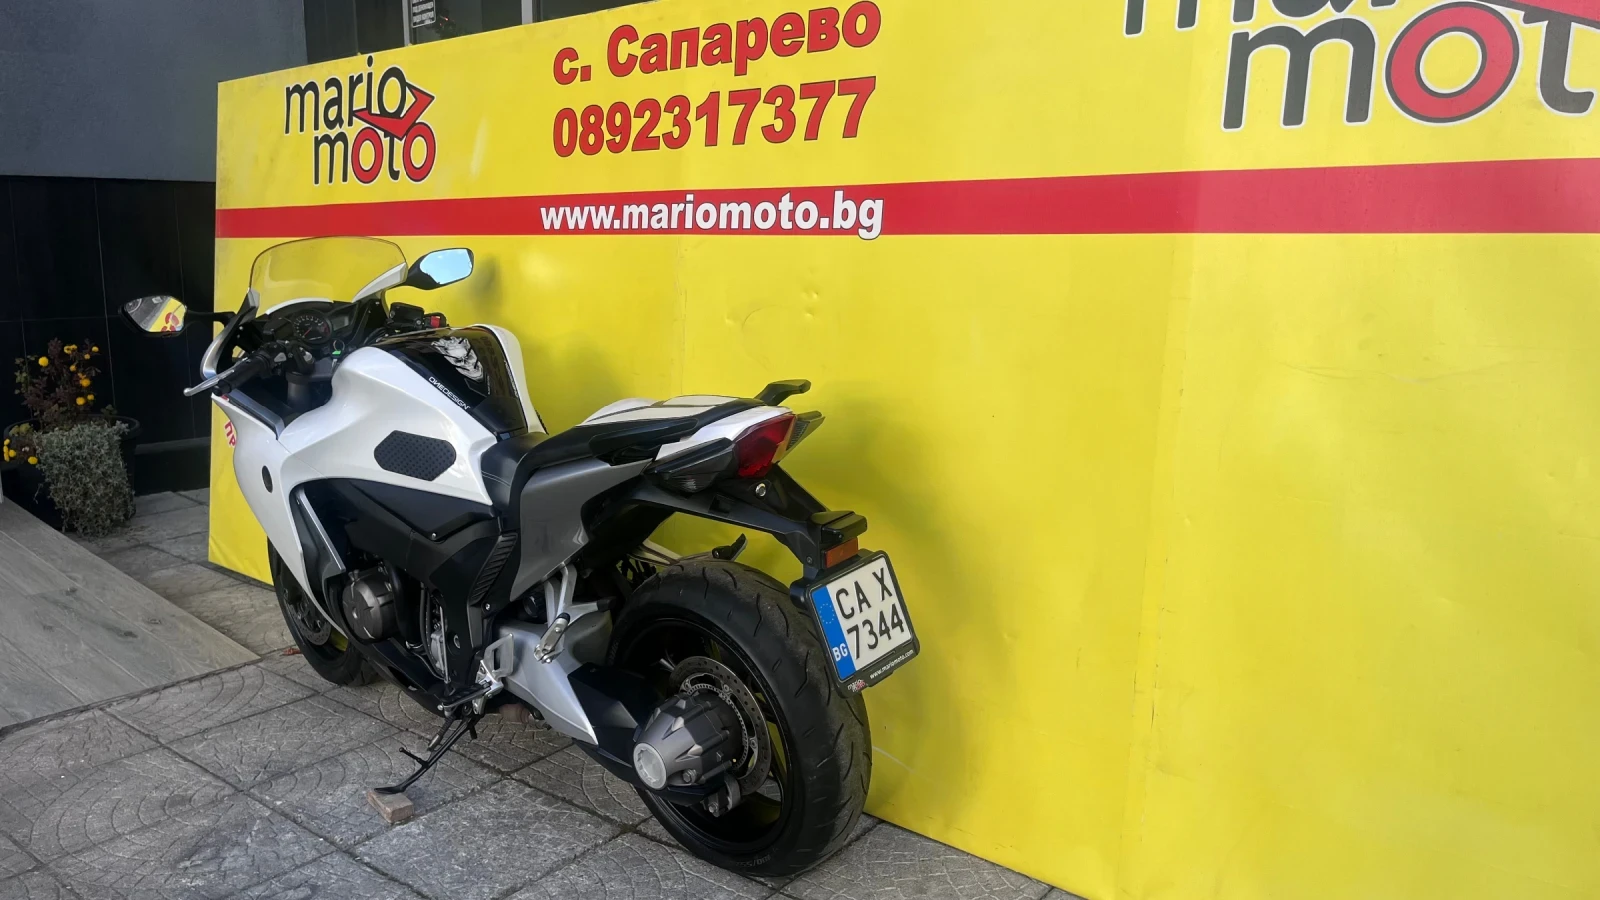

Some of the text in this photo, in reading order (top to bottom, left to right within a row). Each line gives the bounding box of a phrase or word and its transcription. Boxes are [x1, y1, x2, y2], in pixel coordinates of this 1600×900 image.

[553, 0, 882, 85] с. Сапарево
[284, 55, 407, 135] mario
[552, 76, 877, 158] 0892317377
[313, 121, 437, 185] moto
[540, 189, 885, 241] www.mariomoto.bg
[428, 376, 470, 410] ONEDESIGN
[835, 567, 893, 620] CA X
[832, 643, 848, 661] BG
[846, 603, 905, 660] 7344
